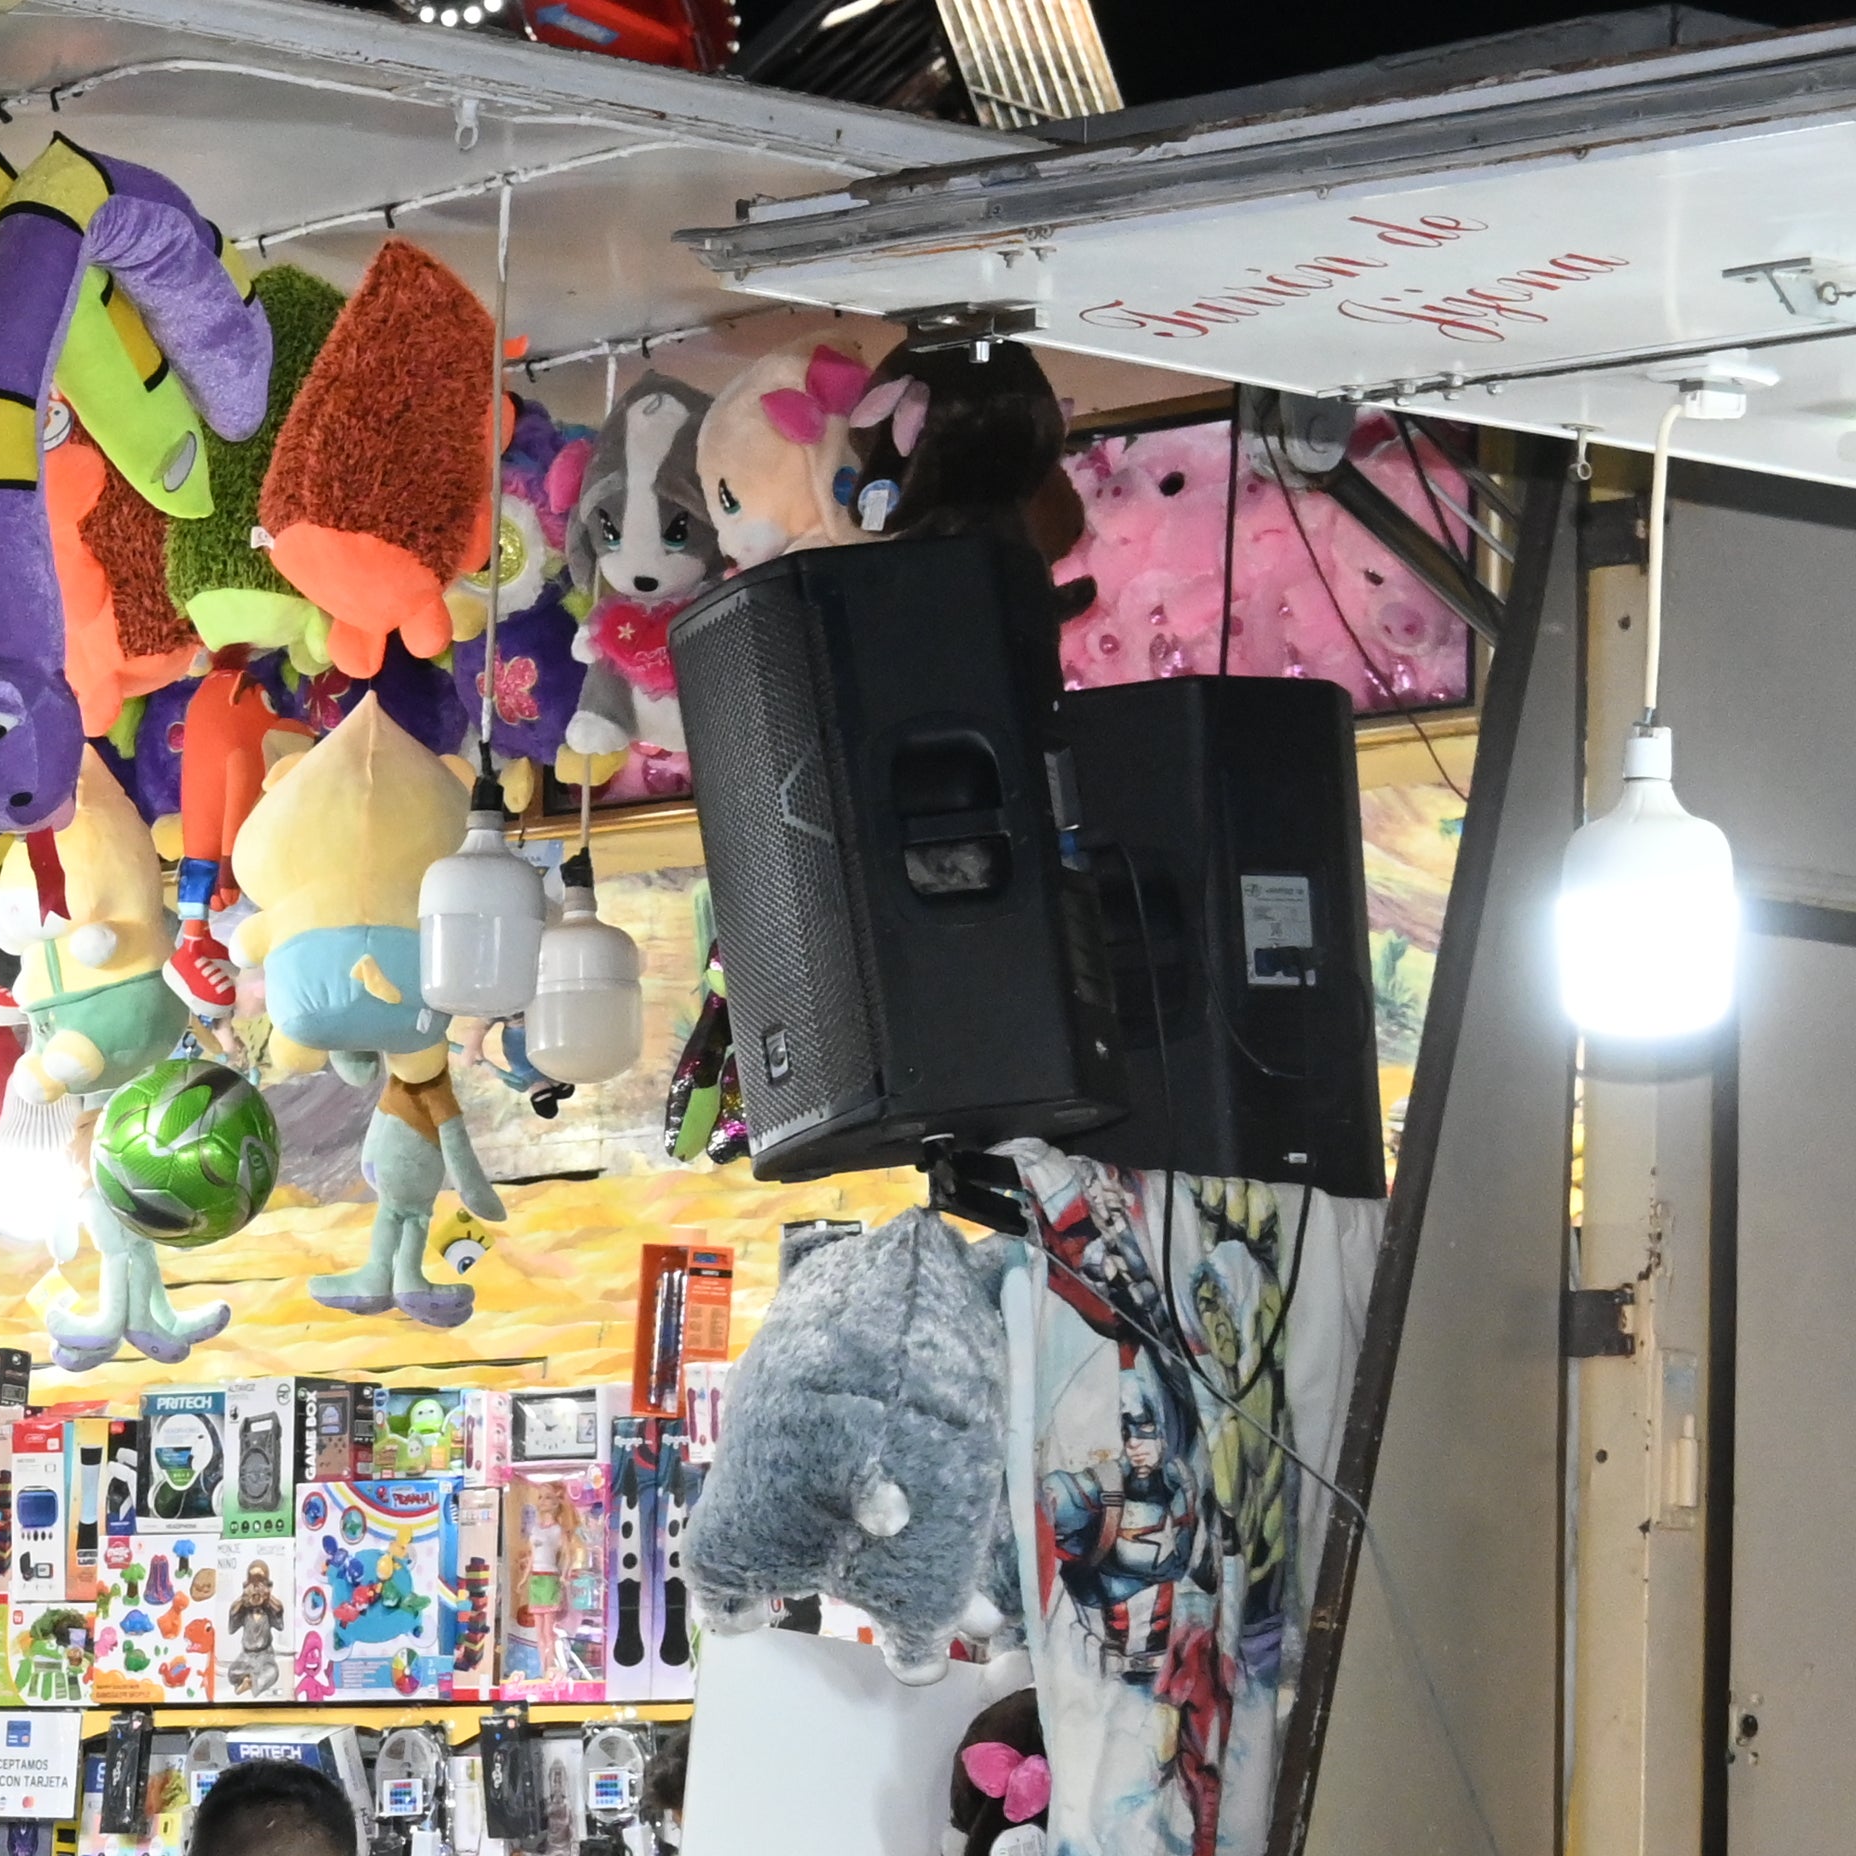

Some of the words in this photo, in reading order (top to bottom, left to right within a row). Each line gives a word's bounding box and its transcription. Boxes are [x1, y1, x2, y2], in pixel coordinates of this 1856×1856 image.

[1349, 214, 1488, 248] de
[156, 1395, 212, 1411] PRITECH
[306, 1390, 318, 1430] BOX
[304, 1432, 316, 1480] GAME
[239, 1743, 303, 1761] PRITECH
[24, 1775, 69, 1789] TARJETA
